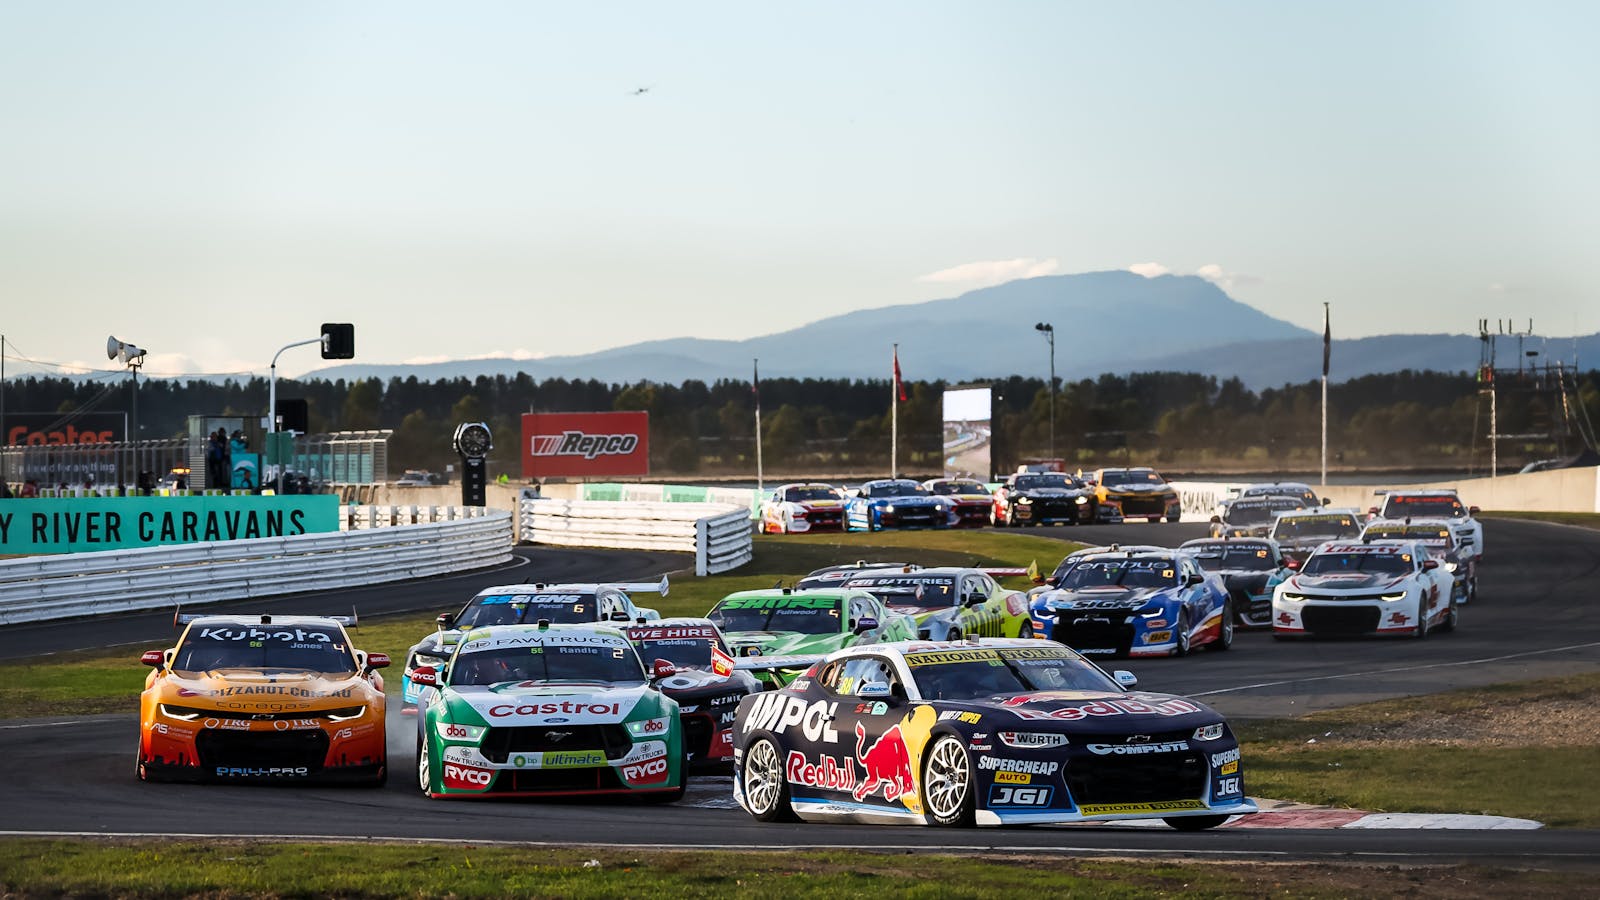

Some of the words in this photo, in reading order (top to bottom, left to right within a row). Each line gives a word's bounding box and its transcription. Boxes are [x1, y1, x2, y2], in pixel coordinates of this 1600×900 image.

[560, 431, 638, 459] Repco
[32, 512, 121, 544] RIVER
[138, 509, 305, 542] CARAVANS
[1325, 544, 1401, 554] Liberty
[574, 604, 584, 613] 6
[200, 629, 331, 643] Kubota
[631, 629, 662, 638] WE
[667, 629, 713, 637] HIRE
[497, 637, 542, 645] FAW
[551, 636, 624, 645] TRUCKS
[333, 643, 346, 653] 4
[612, 648, 623, 659] 2
[908, 650, 997, 664] NATIONAL
[210, 686, 351, 697] PIZZAHUT.COM.AU
[216, 702, 310, 711] coregas
[489, 702, 620, 717] Castrol
[223, 719, 251, 727] TRG
[742, 693, 839, 743] AMPOL
[447, 724, 466, 737] dba
[644, 720, 663, 732] dba
[1086, 741, 1189, 755] COMPLETE
[545, 753, 602, 765] ultimate
[642, 749, 664, 760] TRUCKS
[446, 755, 460, 763] FAW
[462, 759, 488, 768] TRUCKS
[978, 755, 1059, 776] SUPERCHEAP
[444, 765, 492, 785] RYCO
[623, 759, 667, 780] RYCO
[998, 773, 1028, 782] AUTO
[992, 788, 1049, 805] JGI
[1083, 804, 1151, 813] NATIONAL
